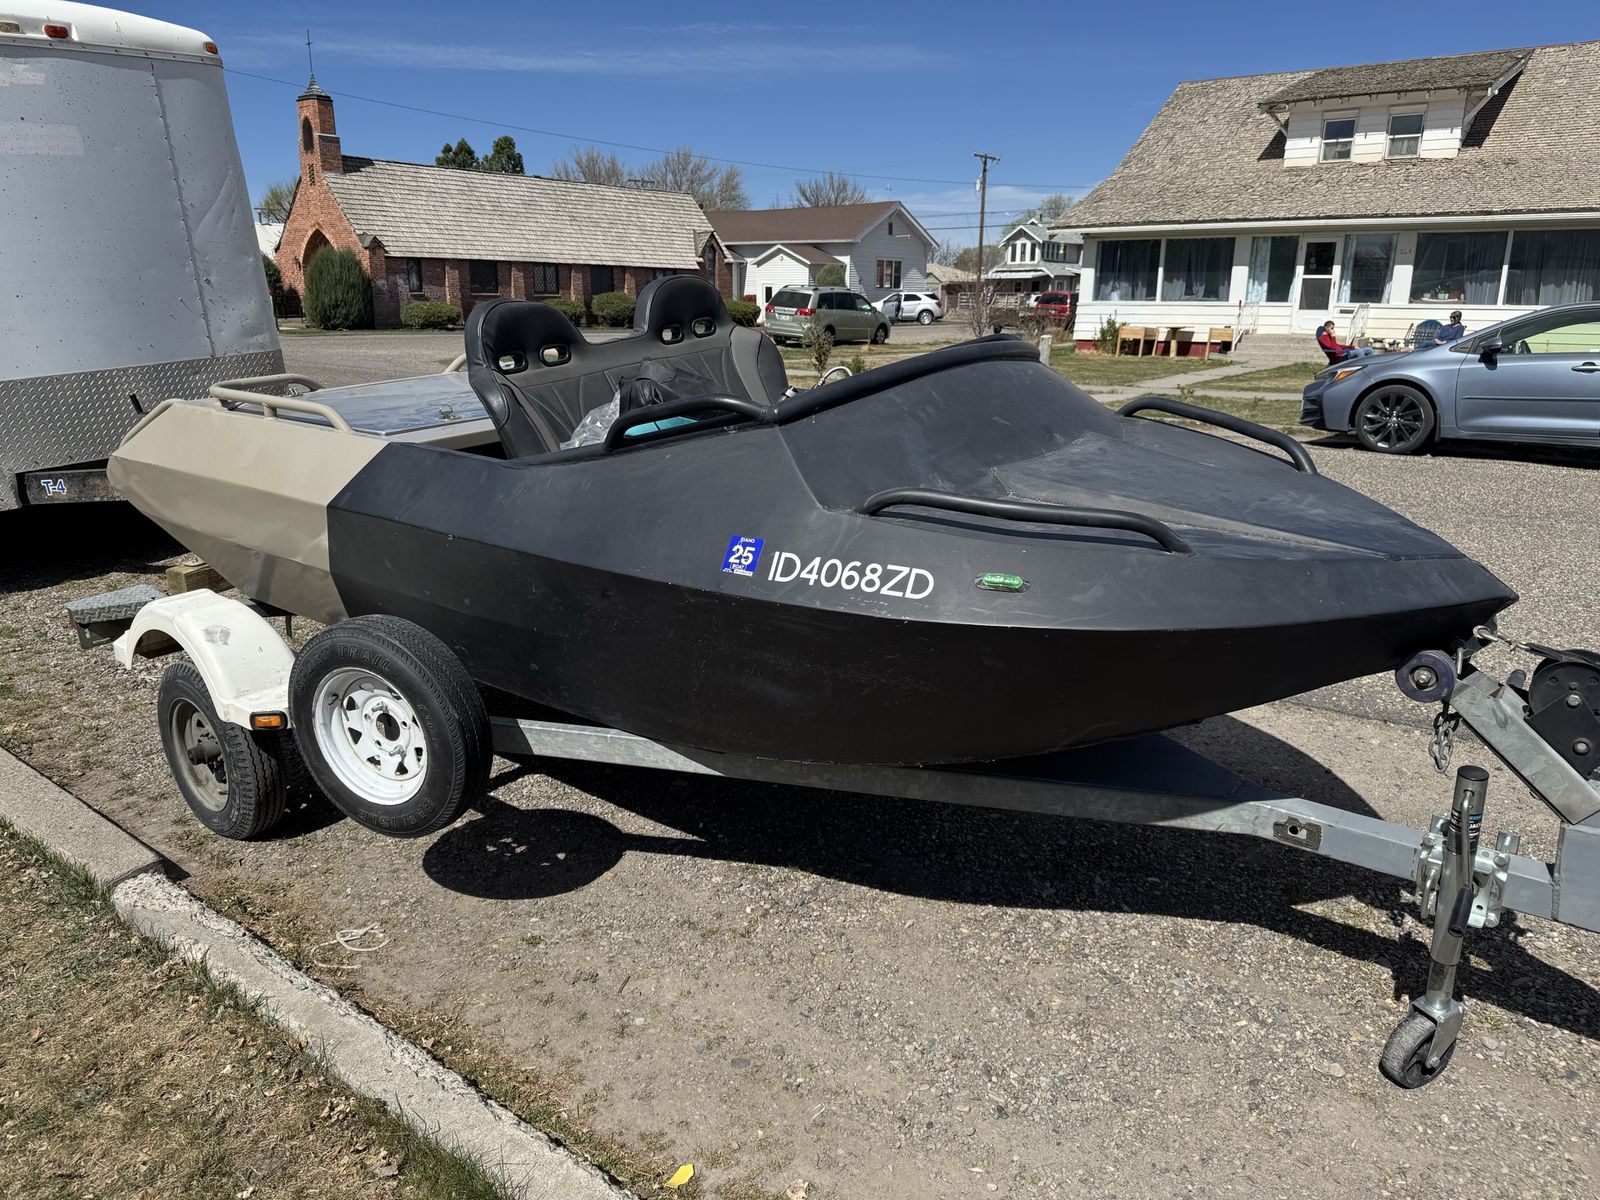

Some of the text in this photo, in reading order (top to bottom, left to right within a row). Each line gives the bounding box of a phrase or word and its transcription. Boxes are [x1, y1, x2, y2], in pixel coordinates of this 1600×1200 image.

[41, 479, 67, 496] T-4
[728, 544, 756, 565] 25
[768, 551, 935, 600] ID4068ZD
[338, 645, 393, 673] TRAIL
